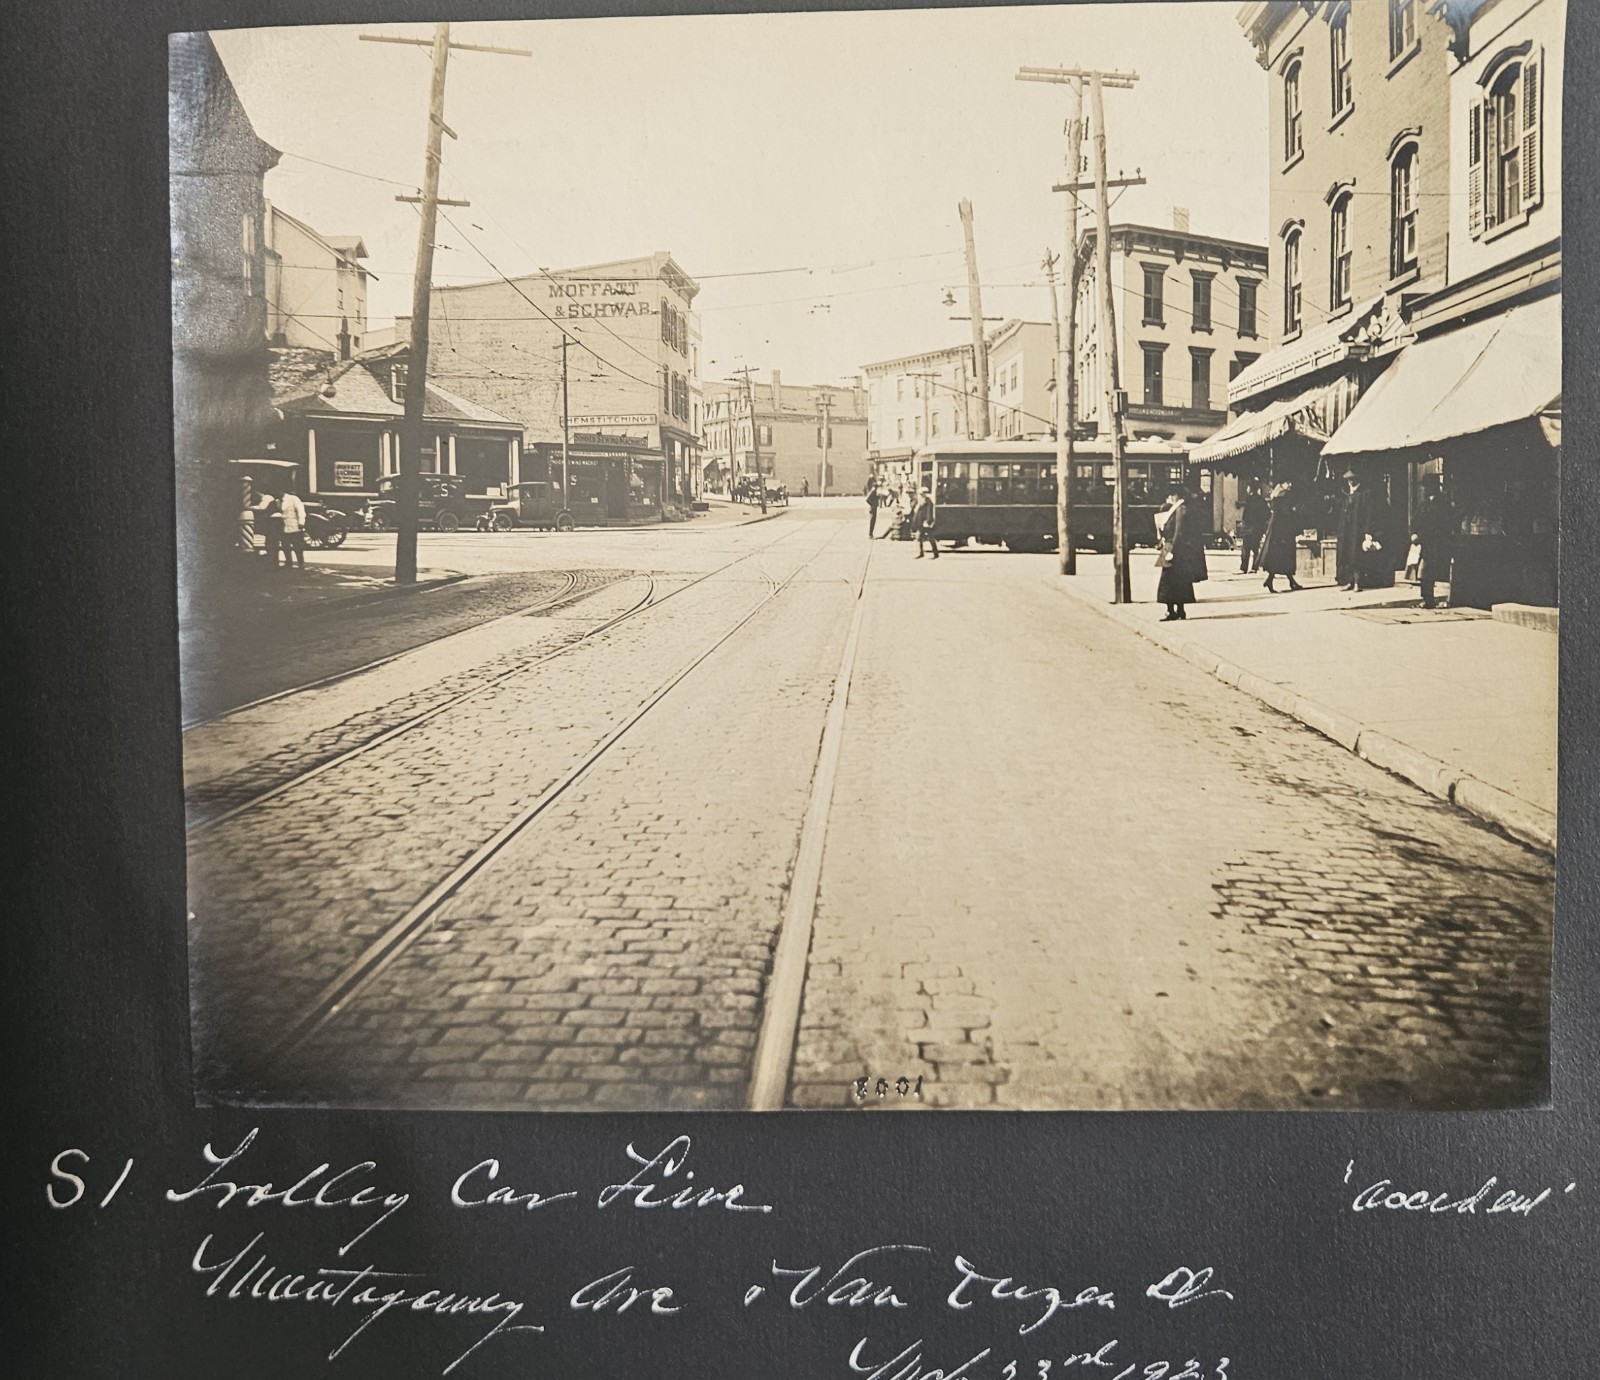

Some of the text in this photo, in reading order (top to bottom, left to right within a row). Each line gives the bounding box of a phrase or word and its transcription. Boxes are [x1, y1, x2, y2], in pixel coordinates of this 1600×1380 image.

[548, 281, 639, 298] MOFFATT
[555, 301, 650, 318] & SCHWAB
[566, 416, 647, 424] HEMSTITCHING
[440, 483, 449, 497] S
[853, 1074, 923, 1100] 8001
[166, 1127, 410, 1256] Trolley
[451, 1158, 577, 1211] Car
[597, 1134, 773, 1210] Line
[771, 1244, 932, 1308] Van
